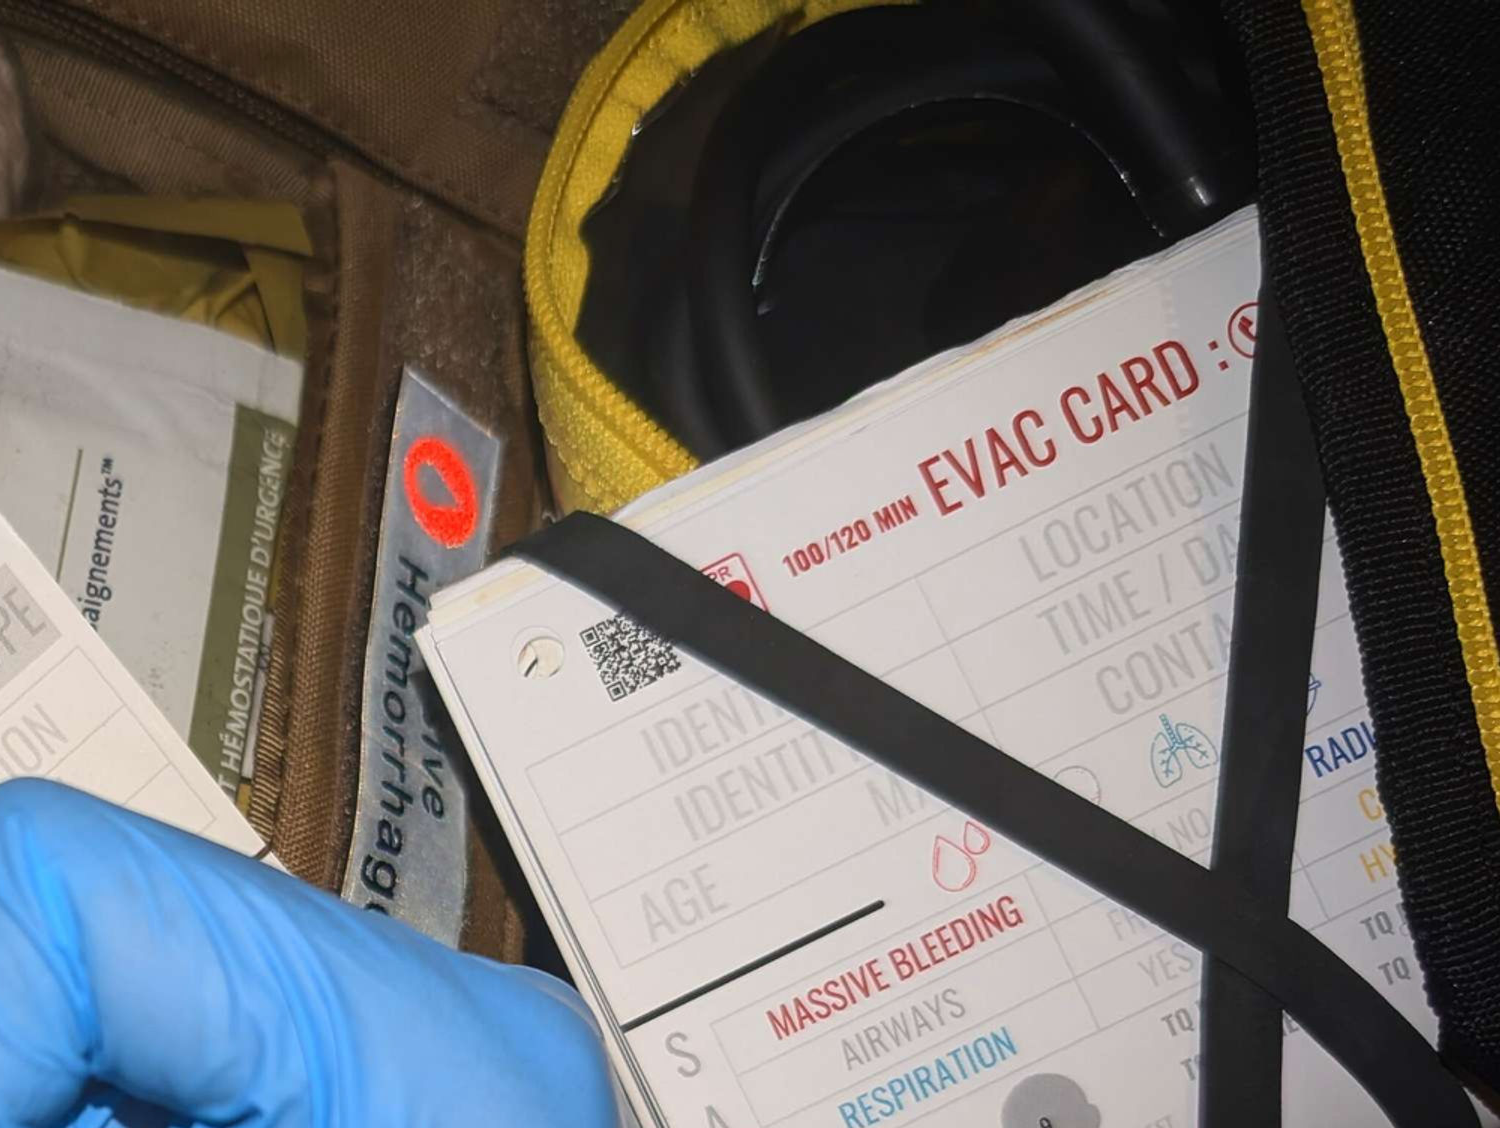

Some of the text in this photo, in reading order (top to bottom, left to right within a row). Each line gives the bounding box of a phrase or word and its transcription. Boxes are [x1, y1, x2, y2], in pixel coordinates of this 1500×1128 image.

[917, 410, 1057, 516] EVAC
[1060, 340, 1200, 444] CARD
[782, 495, 918, 577] 100/120 MIN
[1019, 442, 1235, 583] LOCATION
[1037, 569, 1151, 655] TIME
[1181, 519, 1238, 586] DA
[218, 563, 269, 777] HÉMOSTATIQUE
[640, 685, 784, 775] IDENT
[1305, 721, 1376, 778] RADI
[674, 728, 860, 842] IDENTIT
[639, 863, 729, 944] AGE
[1360, 910, 1395, 941] TQ
[766, 895, 1025, 1040] MASSIVE BLEEDING
[1138, 942, 1194, 988] YES
[1378, 956, 1412, 986] TQ
[841, 988, 967, 1071] AIRWAYS
[1161, 1006, 1195, 1037] TQ
